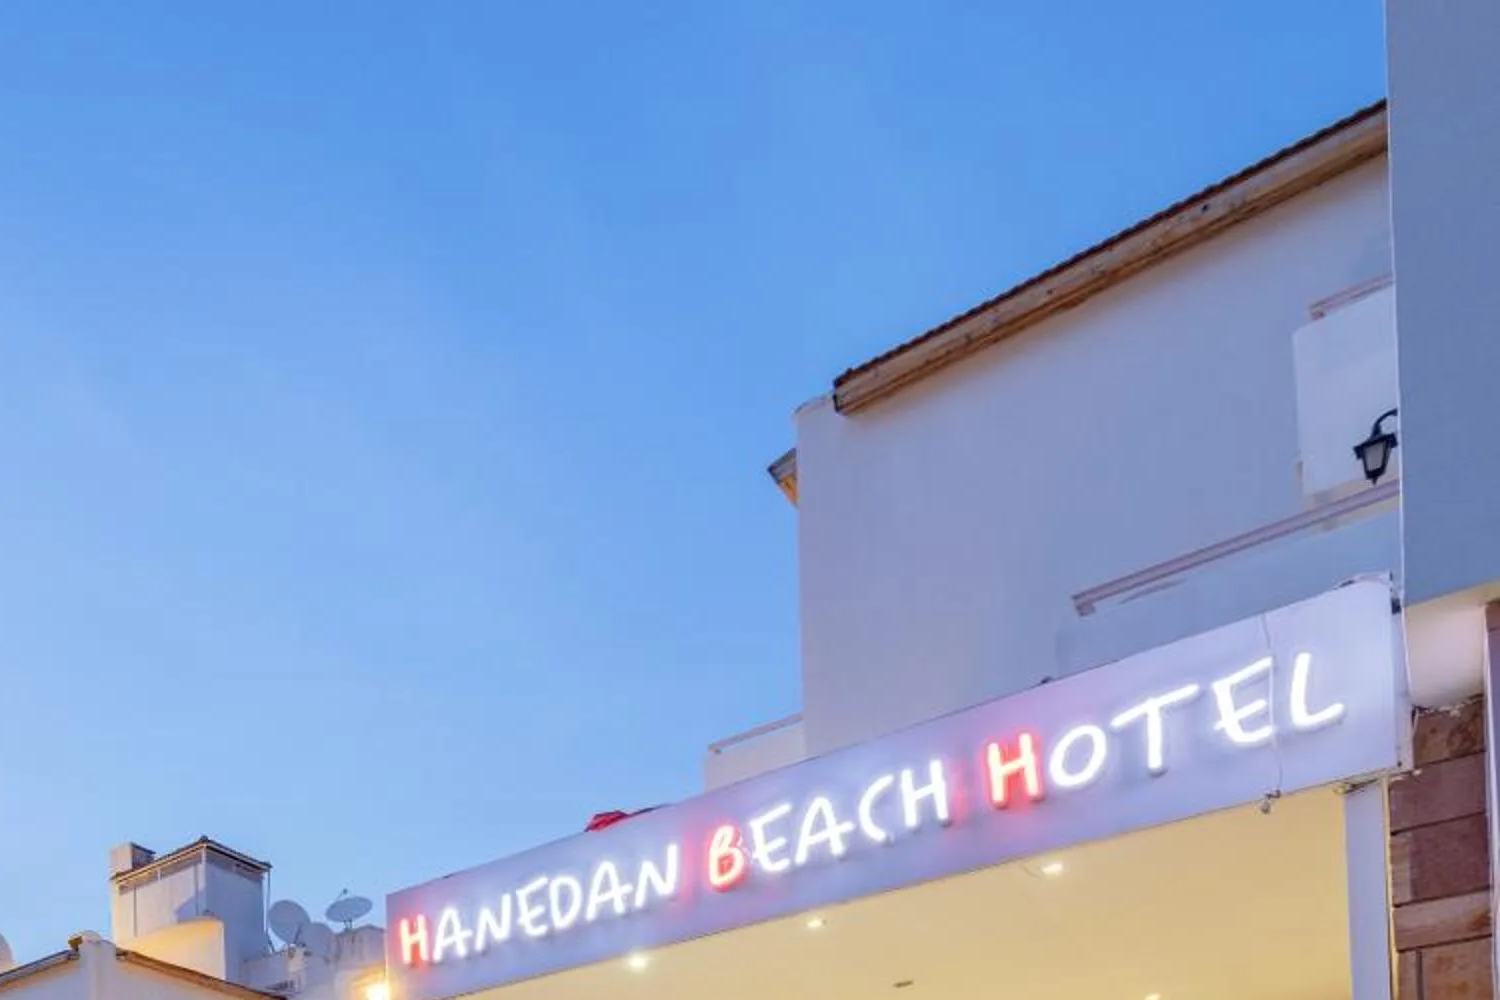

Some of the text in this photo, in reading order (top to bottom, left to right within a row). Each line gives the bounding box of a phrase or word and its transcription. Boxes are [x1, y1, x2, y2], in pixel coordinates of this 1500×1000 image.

[400, 652, 1345, 965] HANEDAN BEACH HOTEL
